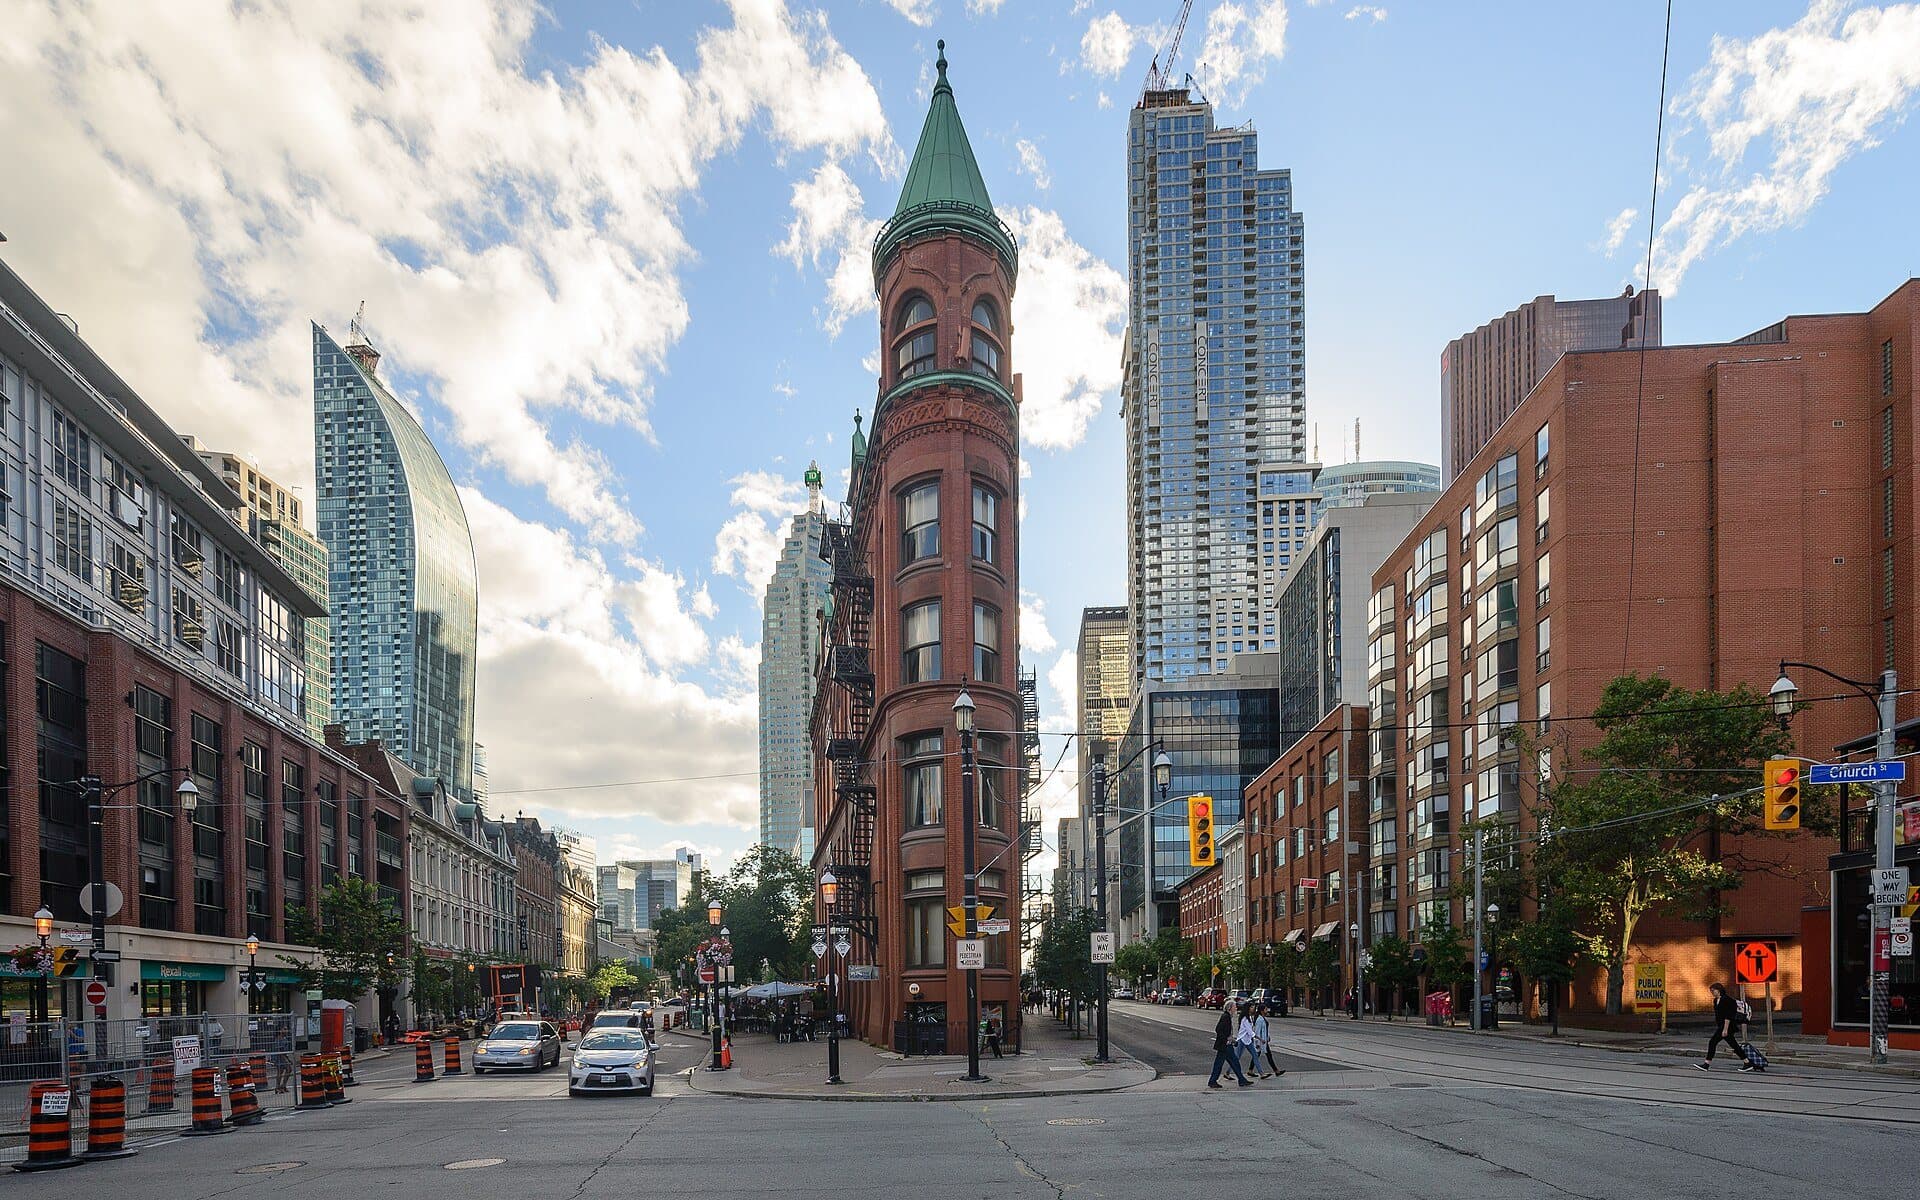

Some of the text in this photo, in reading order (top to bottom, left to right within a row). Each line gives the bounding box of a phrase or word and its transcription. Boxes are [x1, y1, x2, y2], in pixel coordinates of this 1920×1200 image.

[1197, 336, 1206, 404] CONCERT
[1149, 342, 1158, 410] CONCERT
[1829, 765, 1877, 778] Church
[1881, 870, 1901, 880] ONE
[1883, 882, 1900, 892] WAY
[1876, 893, 1906, 904] BEGINS
[965, 943, 976, 951] NO
[1097, 943, 1109, 951] WAY
[1092, 953, 1114, 961] BEGINS
[160, 965, 182, 977] Rexall
[1638, 978, 1662, 988] PUBLIC
[1635, 989, 1665, 999] PARKING
[175, 1047, 199, 1059] DANGER
